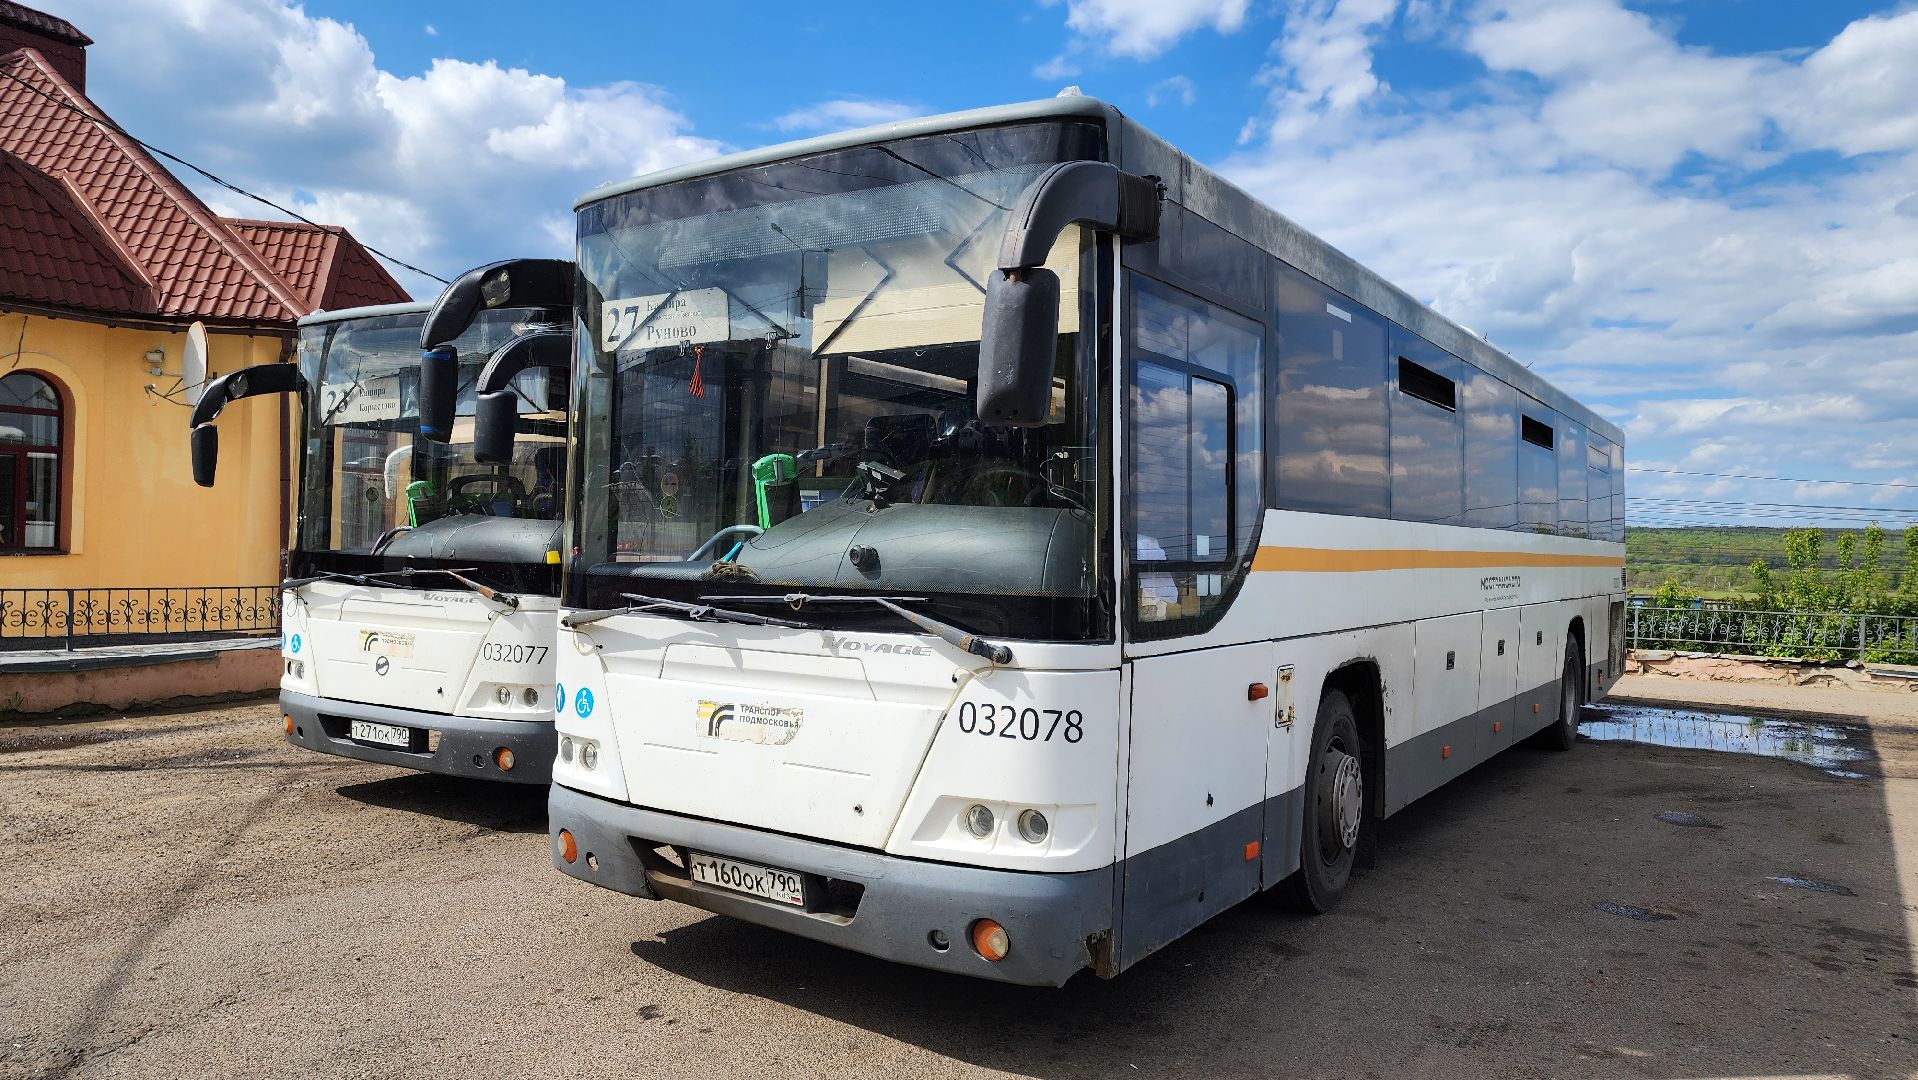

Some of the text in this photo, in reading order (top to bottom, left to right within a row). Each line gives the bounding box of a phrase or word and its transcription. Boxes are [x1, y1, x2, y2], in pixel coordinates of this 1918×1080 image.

[607, 305, 639, 342] 27
[646, 325, 697, 340] Руново
[483, 642, 549, 665] 032077
[740, 704, 789, 717] ТРАНСПОР
[958, 701, 1084, 744] 032078
[768, 871, 796, 893] 790
